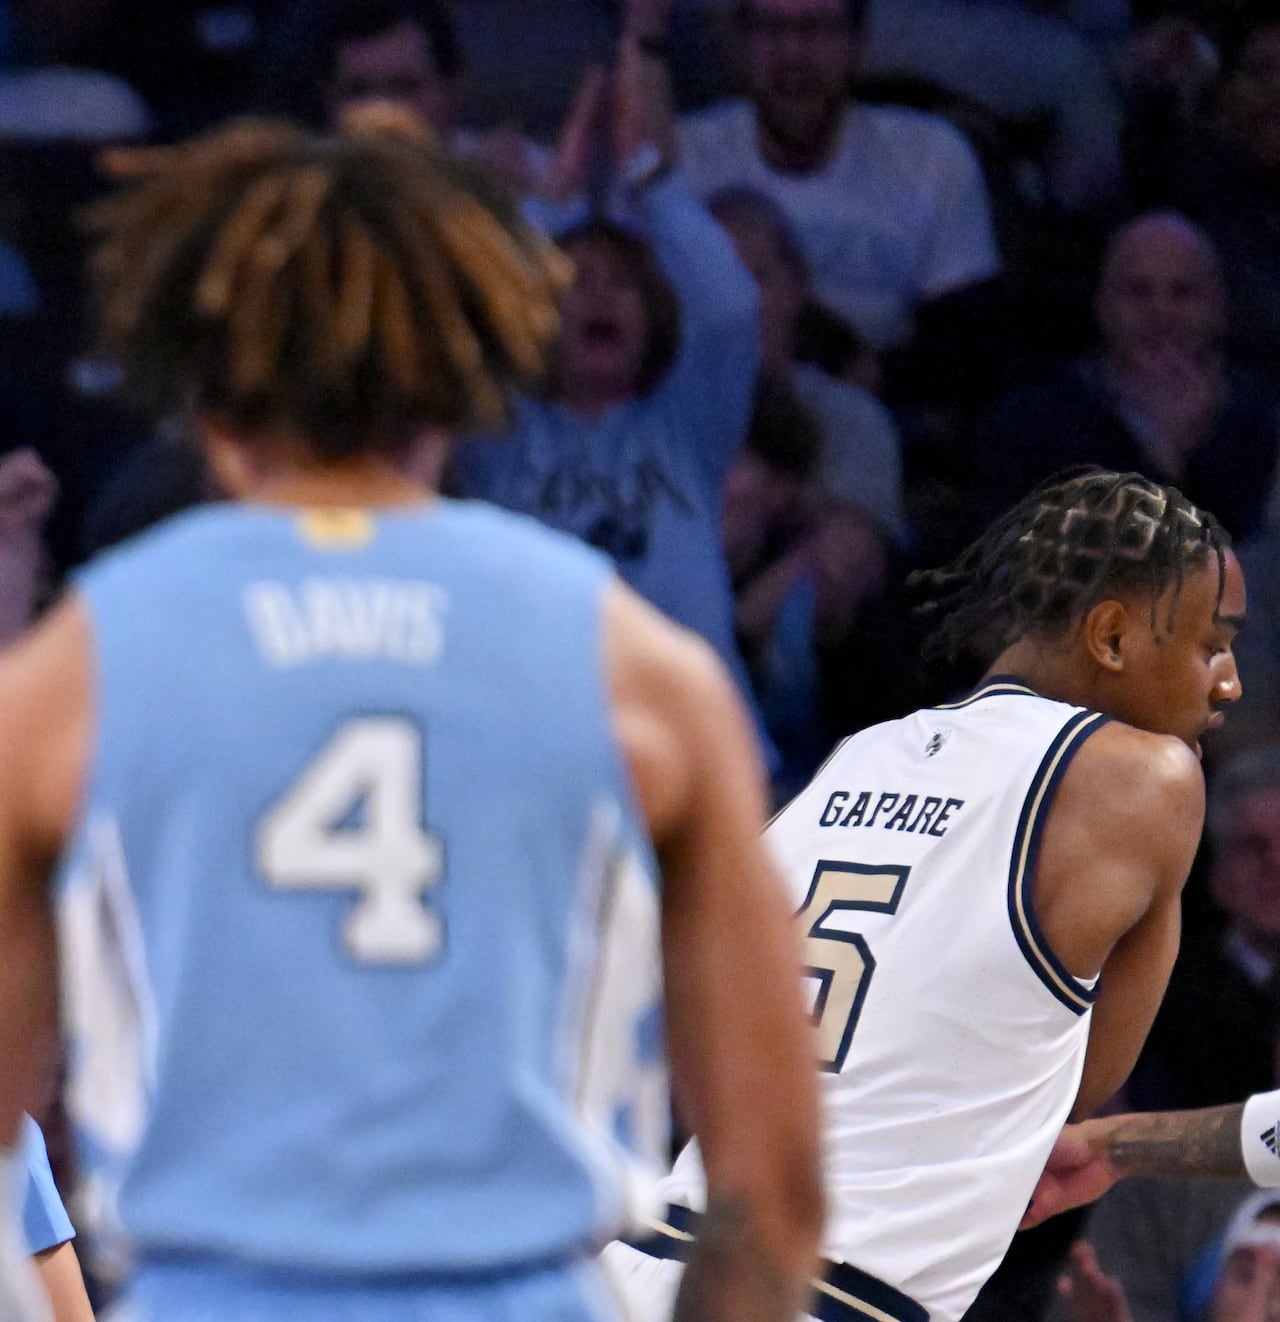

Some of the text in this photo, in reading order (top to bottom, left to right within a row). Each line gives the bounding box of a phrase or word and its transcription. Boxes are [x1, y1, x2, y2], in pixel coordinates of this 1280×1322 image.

[244, 576, 450, 668] DAVIS
[252, 711, 446, 966] 4
[819, 791, 965, 837] GAPARE
[792, 859, 912, 1074] 5
